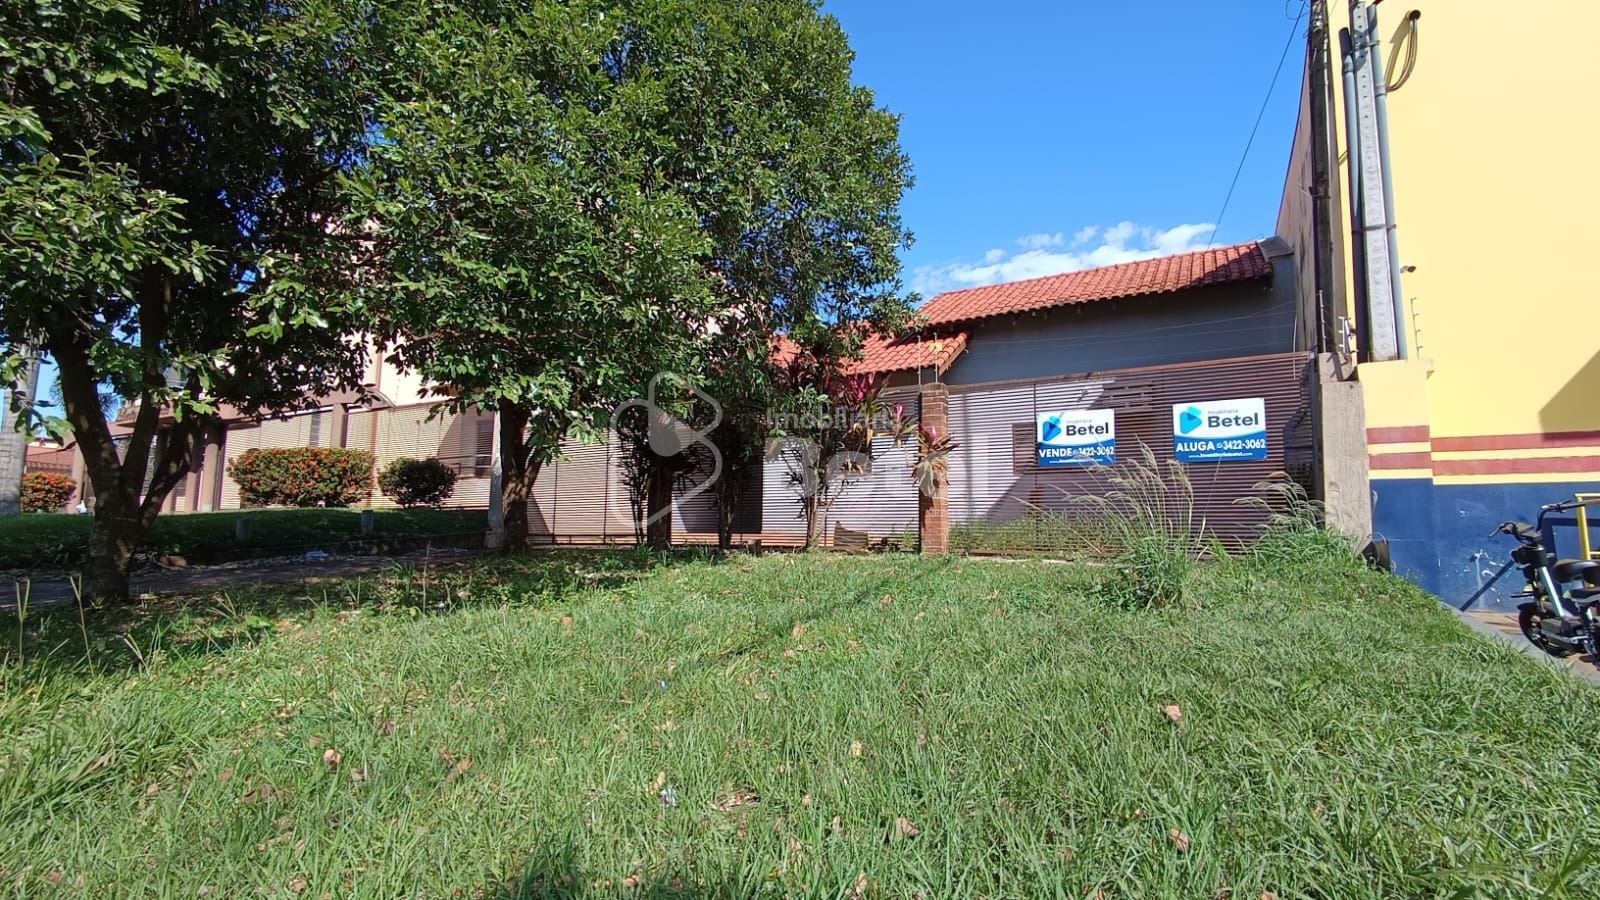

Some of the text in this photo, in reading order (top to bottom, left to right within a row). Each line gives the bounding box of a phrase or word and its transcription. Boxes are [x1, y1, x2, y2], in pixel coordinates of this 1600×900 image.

[1207, 412, 1259, 428] Betel
[1066, 422, 1109, 436] Betel
[1175, 438, 1267, 452] ALUGA 3422-3062
[1038, 447, 1073, 458] VENDE
